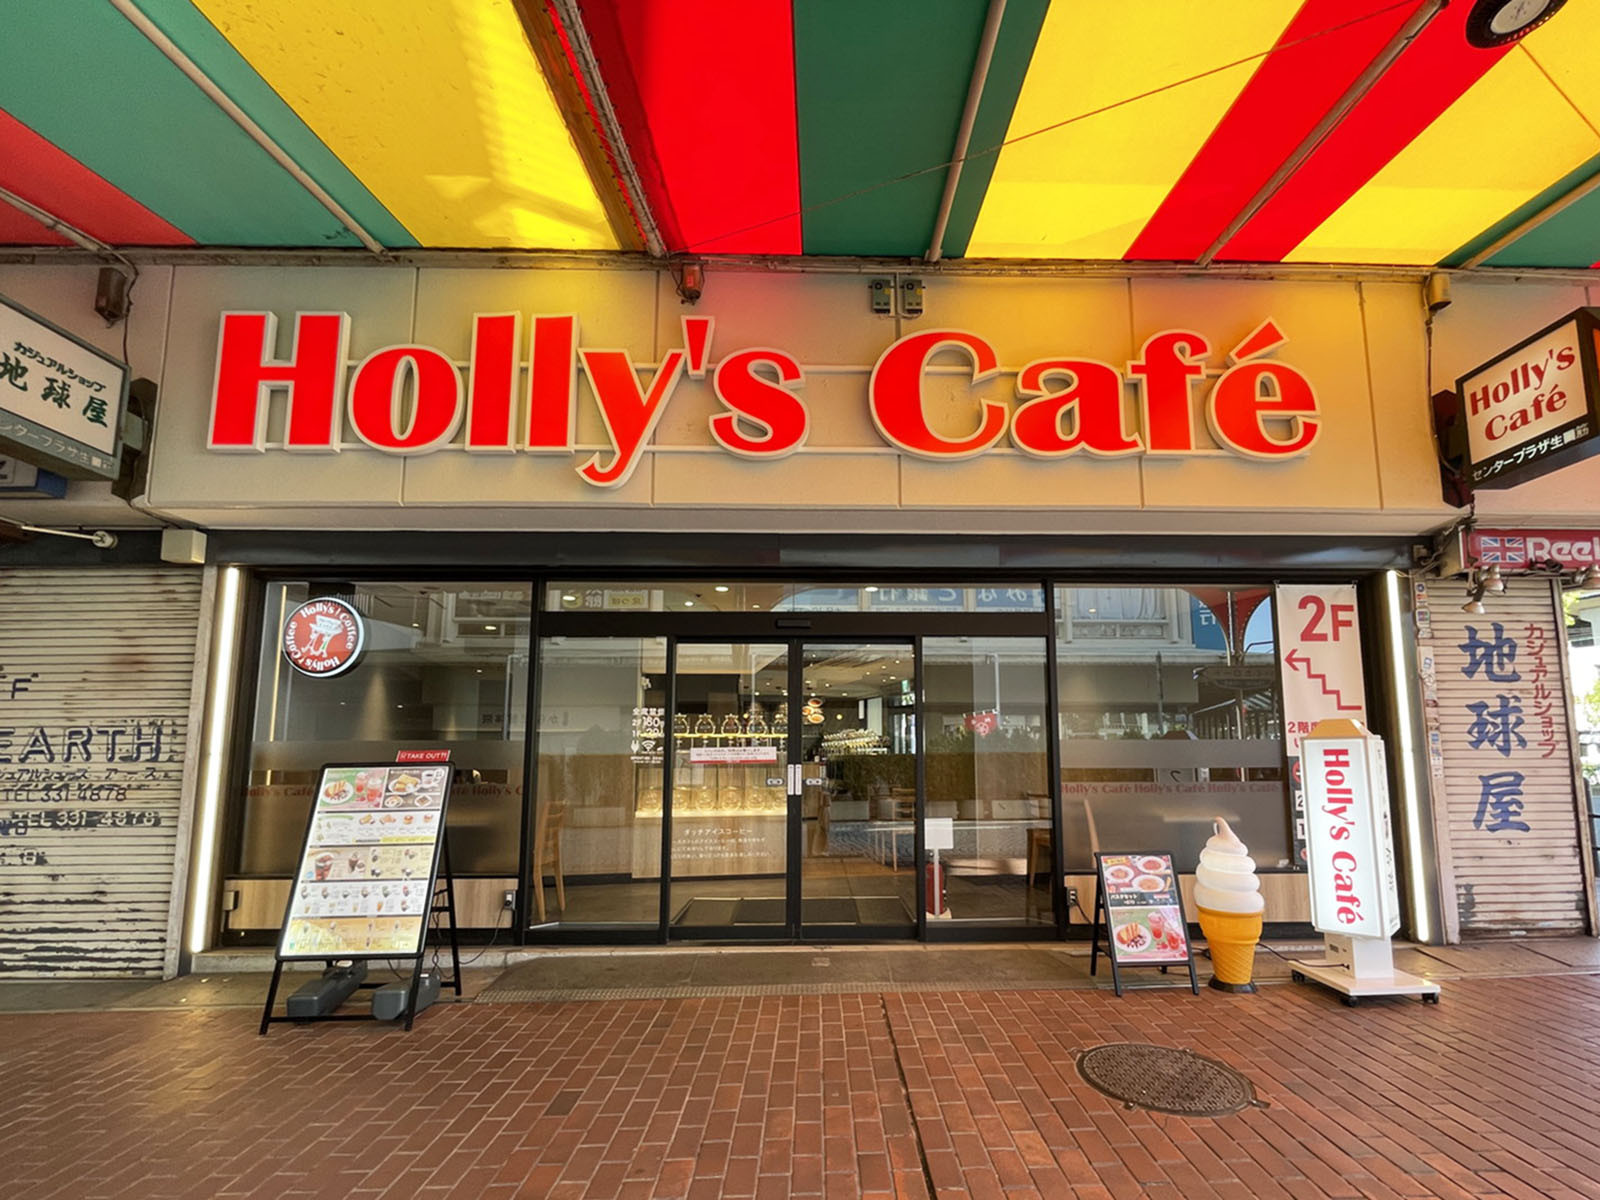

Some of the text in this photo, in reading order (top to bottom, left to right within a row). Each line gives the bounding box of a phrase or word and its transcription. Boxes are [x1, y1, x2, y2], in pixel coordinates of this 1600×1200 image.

[14, 341, 106, 392] カジュアルショップ
[208, 311, 1321, 488] Holly's Café
[1469, 346, 1576, 417] Holly's
[1484, 384, 1567, 441] Café
[1472, 423, 1590, 481] センタープラザ生筋
[1298, 595, 1354, 642] 2F
[1524, 623, 1557, 759] カジュアルショップ
[1458, 622, 1531, 834] 地球屋
[1321, 749, 1364, 925] Holly's Café
